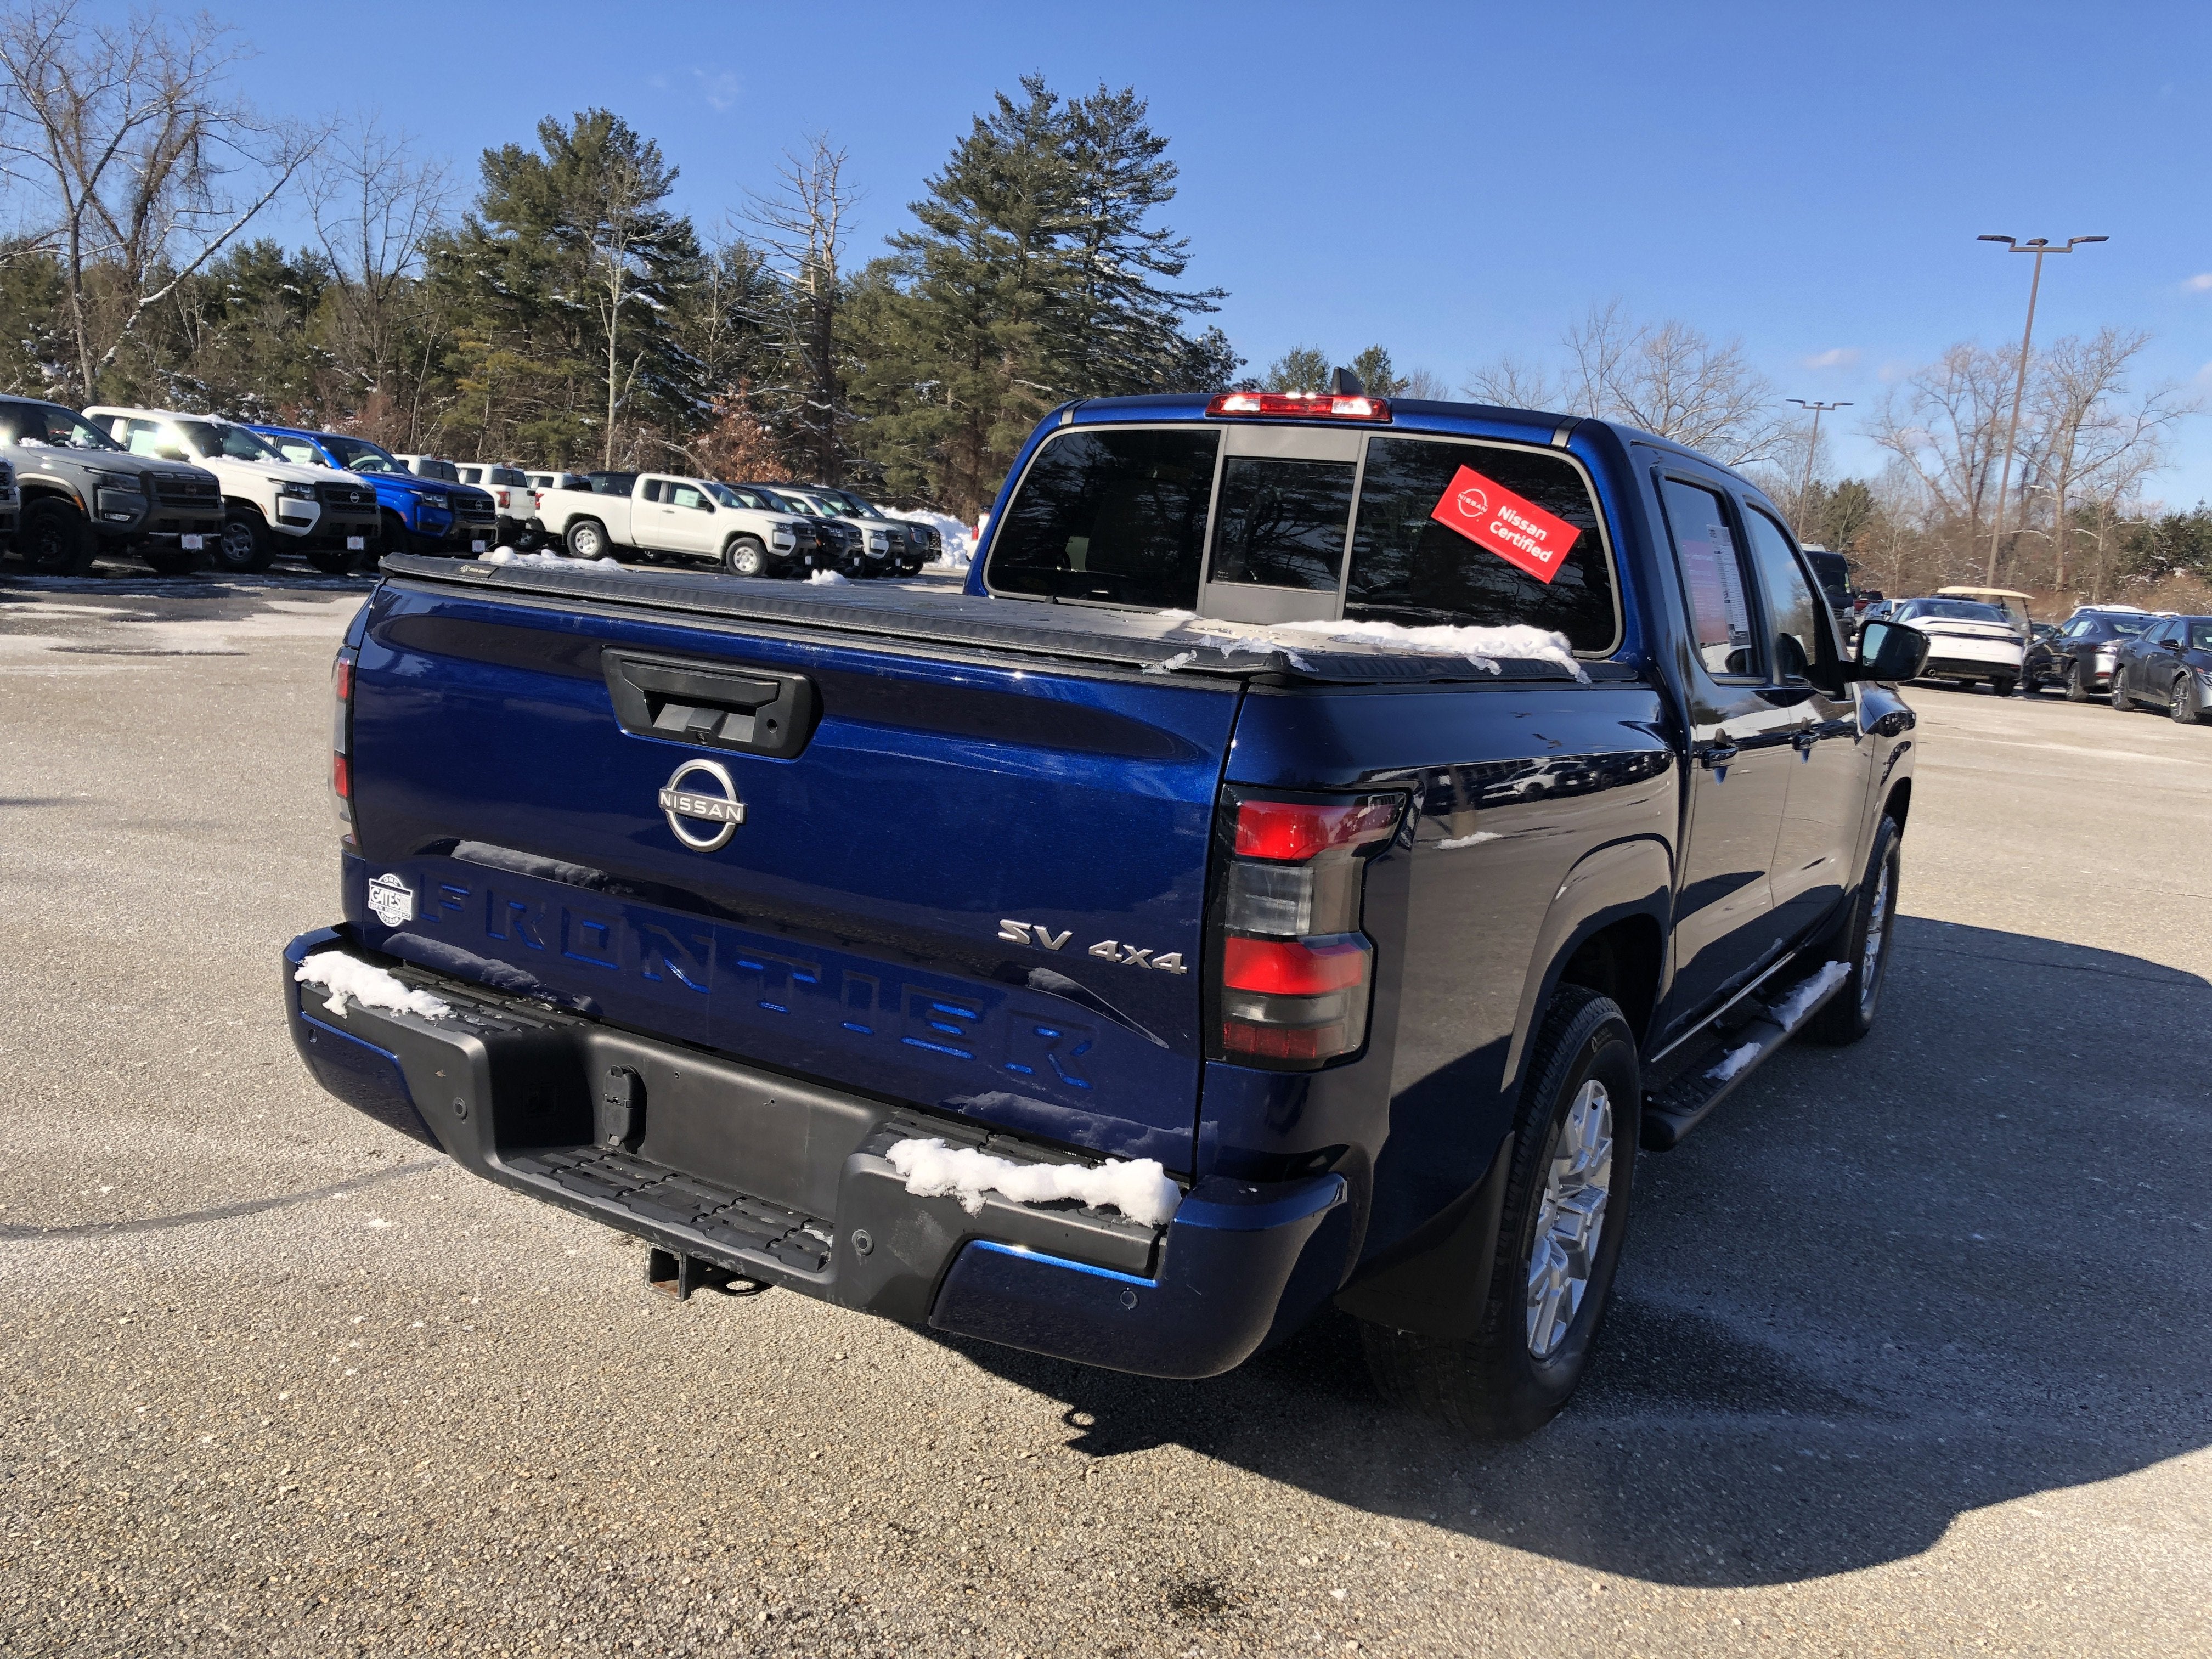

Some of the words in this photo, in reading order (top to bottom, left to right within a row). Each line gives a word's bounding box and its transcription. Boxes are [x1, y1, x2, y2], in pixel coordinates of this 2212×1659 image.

[1457, 493, 1488, 513] NISSAN
[1497, 505, 1547, 541] Nissan
[1489, 521, 1553, 563] Certified
[660, 792, 741, 822] NISSAN
[371, 887, 401, 910] GATES
[380, 912, 399, 924] NISSAN
[997, 918, 1073, 951] SV
[418, 872, 1094, 1090] FRONTIER
